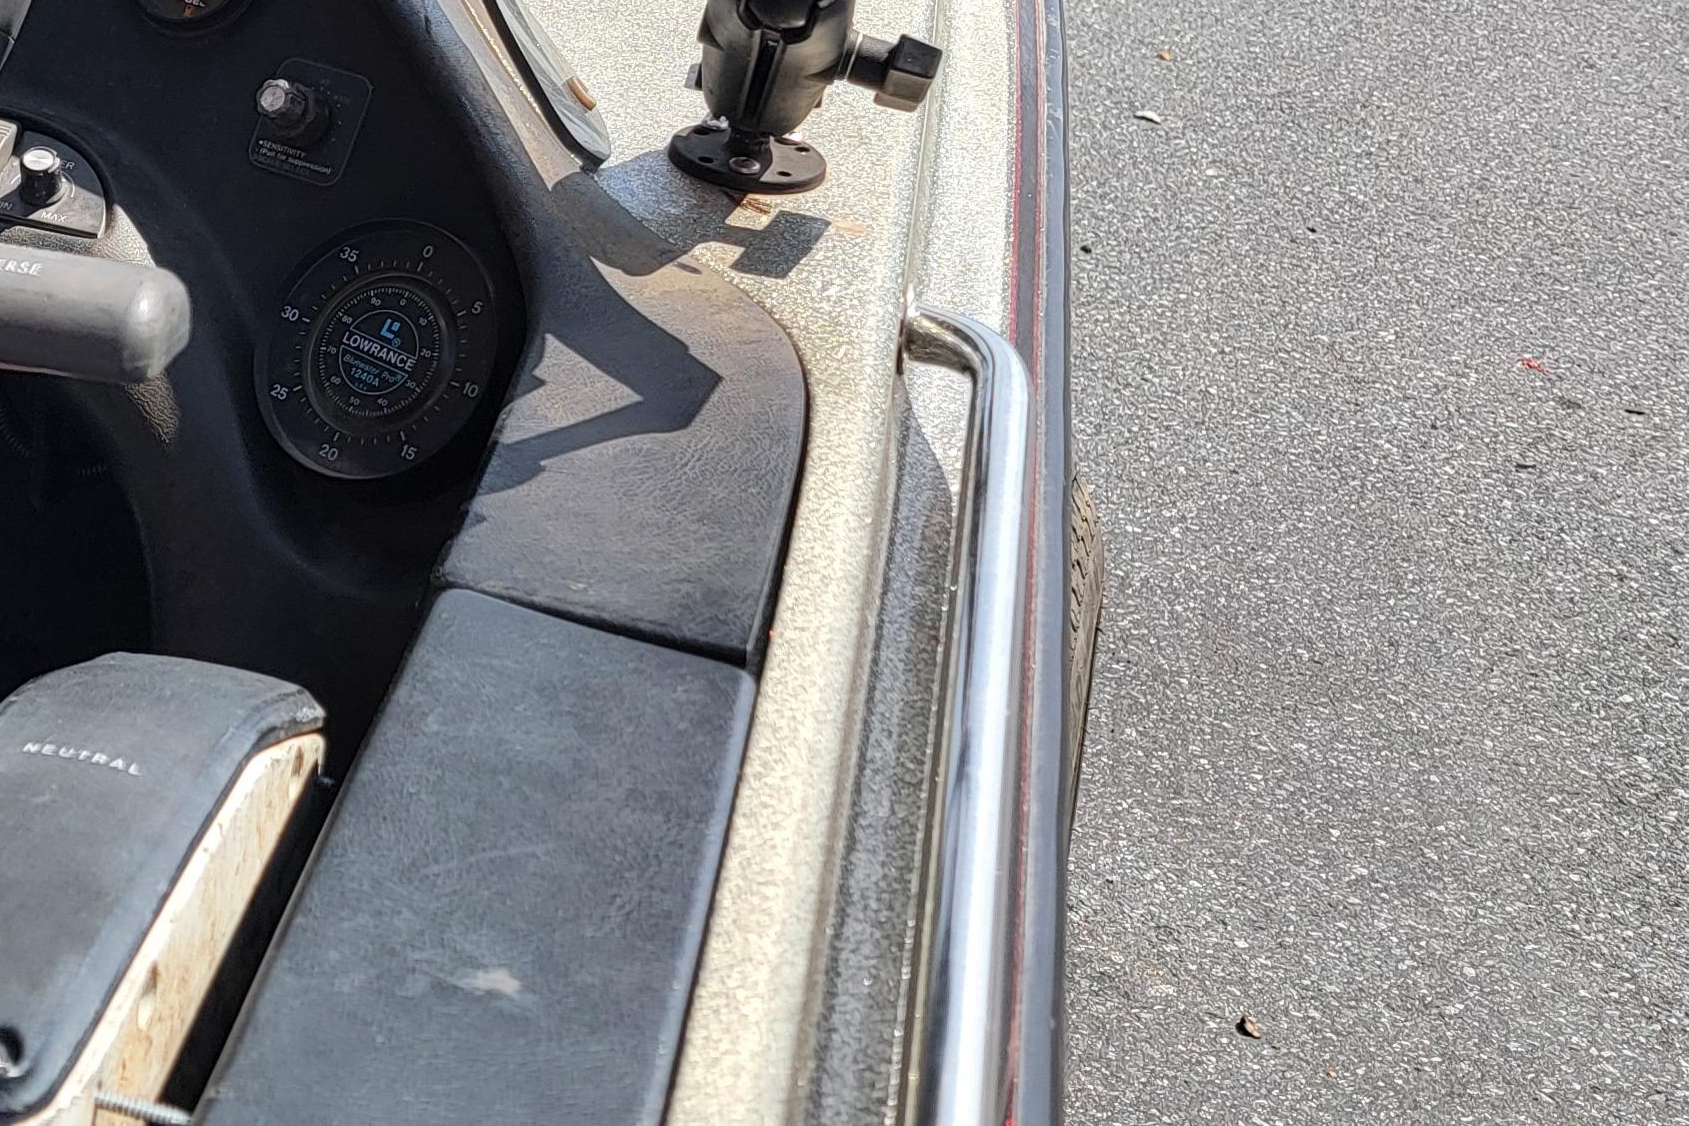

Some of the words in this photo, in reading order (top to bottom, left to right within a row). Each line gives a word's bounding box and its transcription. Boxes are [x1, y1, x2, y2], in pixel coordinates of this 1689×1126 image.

[263, 140, 306, 158] SENSITIVITY
[41, 210, 67, 223] MAX
[339, 246, 360, 263] 35
[422, 245, 434, 258] 0
[281, 305, 300, 322] 30
[471, 301, 484, 314] 5
[342, 331, 417, 372] LOWRANCE
[350, 367, 381, 387] 1240A
[270, 384, 289, 400] 25
[463, 381, 479, 398] 10
[319, 443, 339, 461] 20
[400, 444, 418, 460] 15
[22, 742, 142, 777] NEUTRAL
